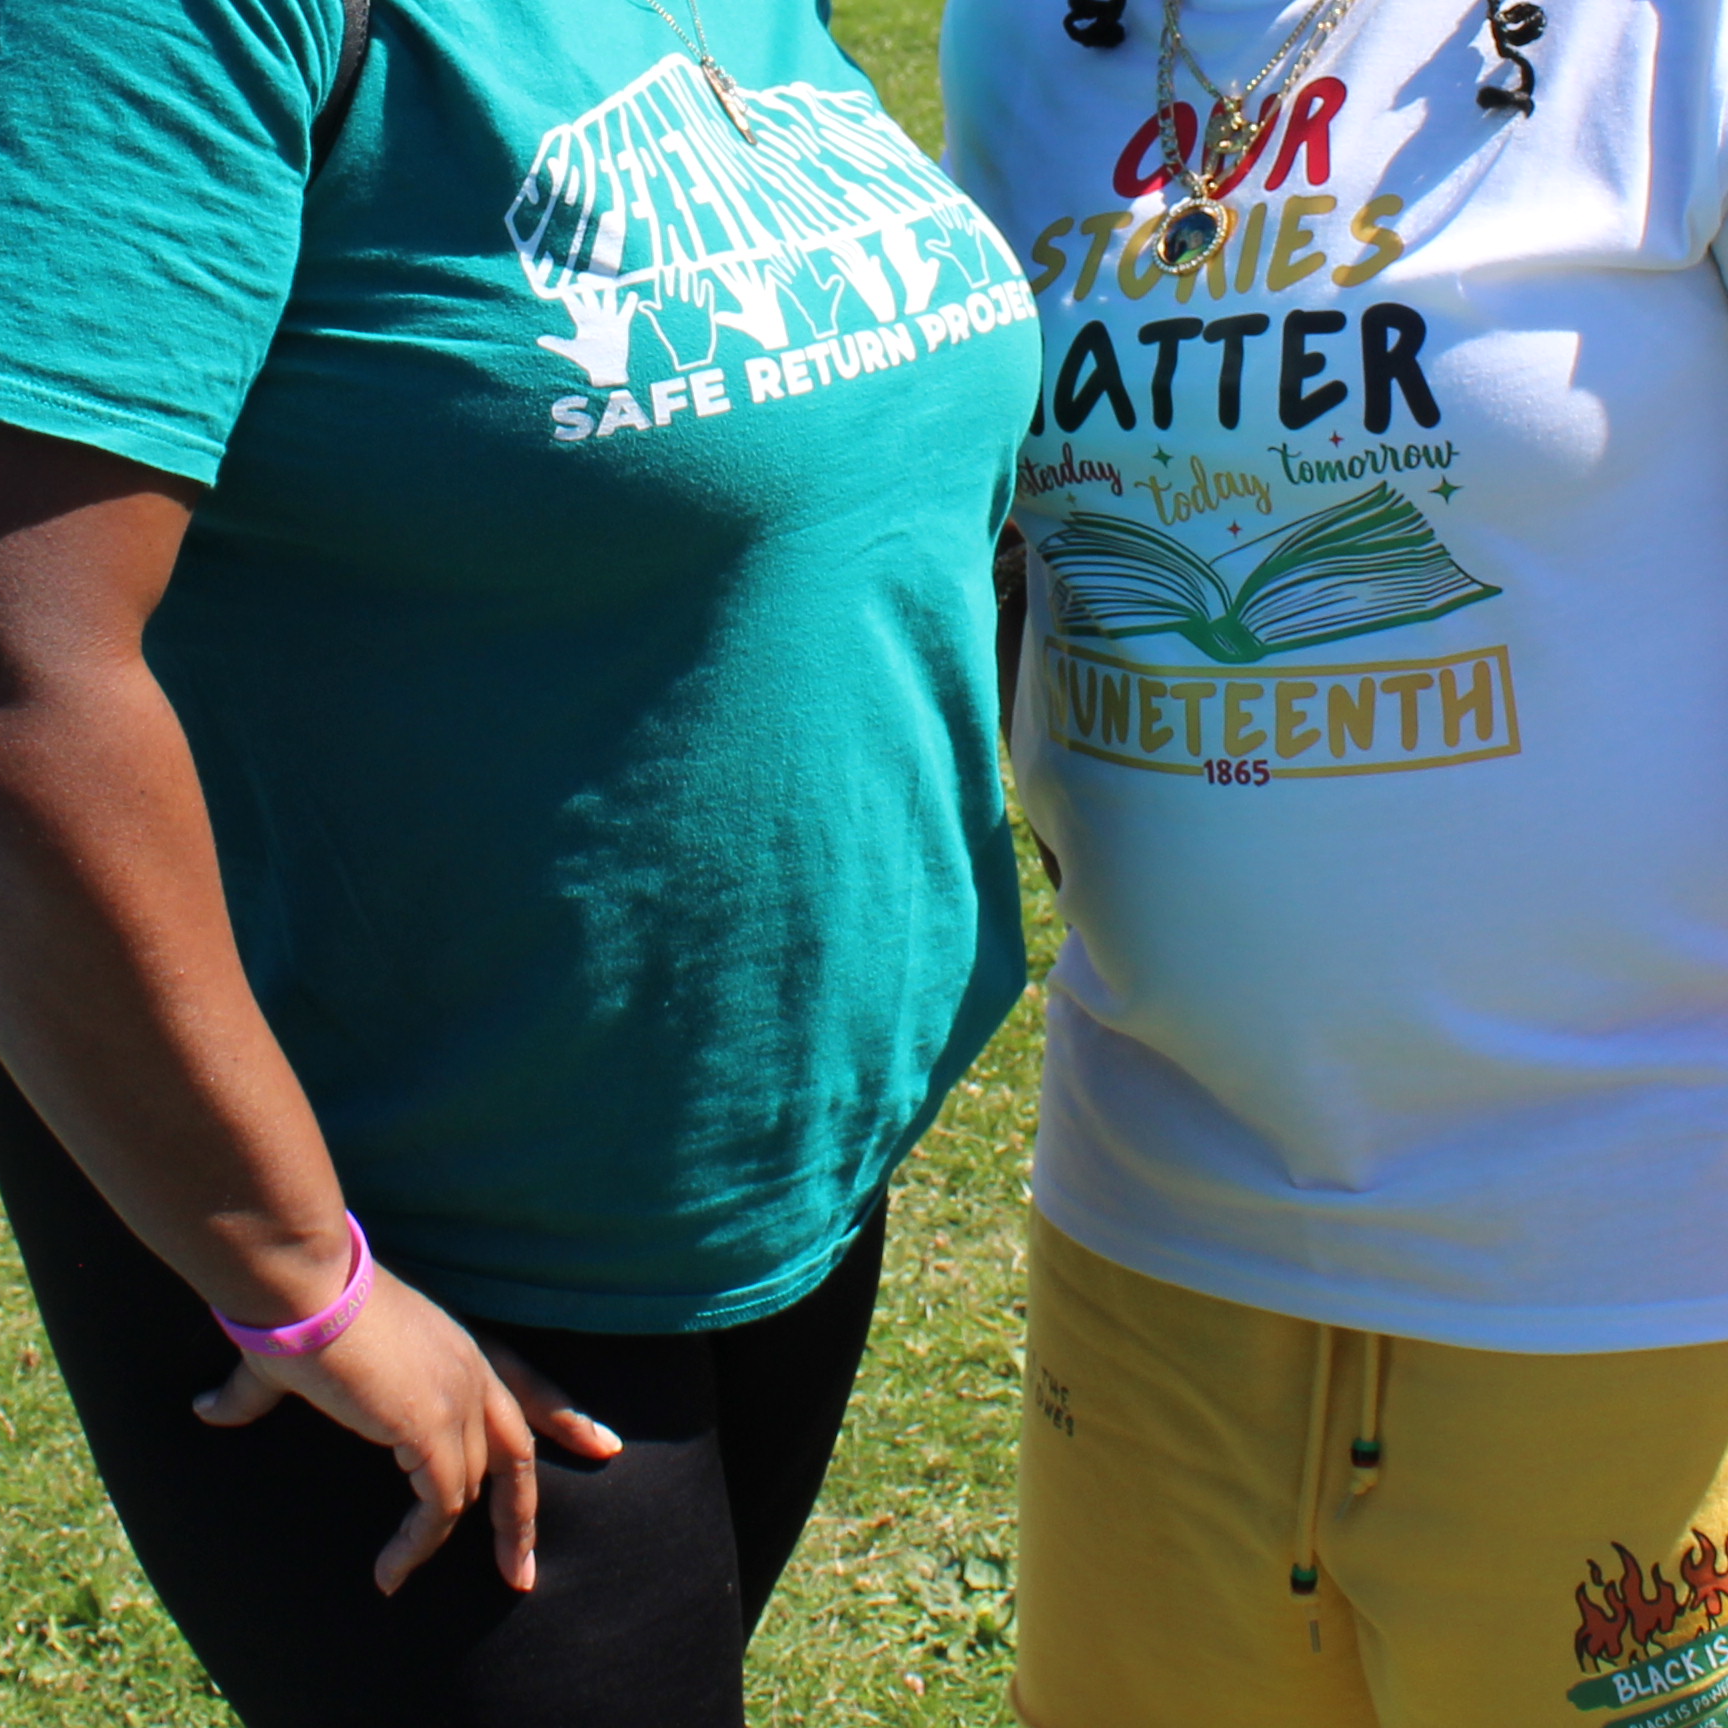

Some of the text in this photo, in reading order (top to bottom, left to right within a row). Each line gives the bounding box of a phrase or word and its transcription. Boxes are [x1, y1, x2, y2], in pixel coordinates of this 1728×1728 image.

[1112, 76, 1347, 200] OUR
[550, 367, 732, 442] SAFE
[744, 322, 917, 404] RETURN
[1134, 455, 1272, 527] today
[1267, 439, 1461, 486] tomorrow
[1051, 657, 1495, 760] JUNETEENTH
[1202, 759, 1271, 787] 1865
[264, 1272, 373, 1352] SHE READY
[1612, 1647, 1706, 1706] BLACK
[1674, 1703, 1692, 1721] IS
